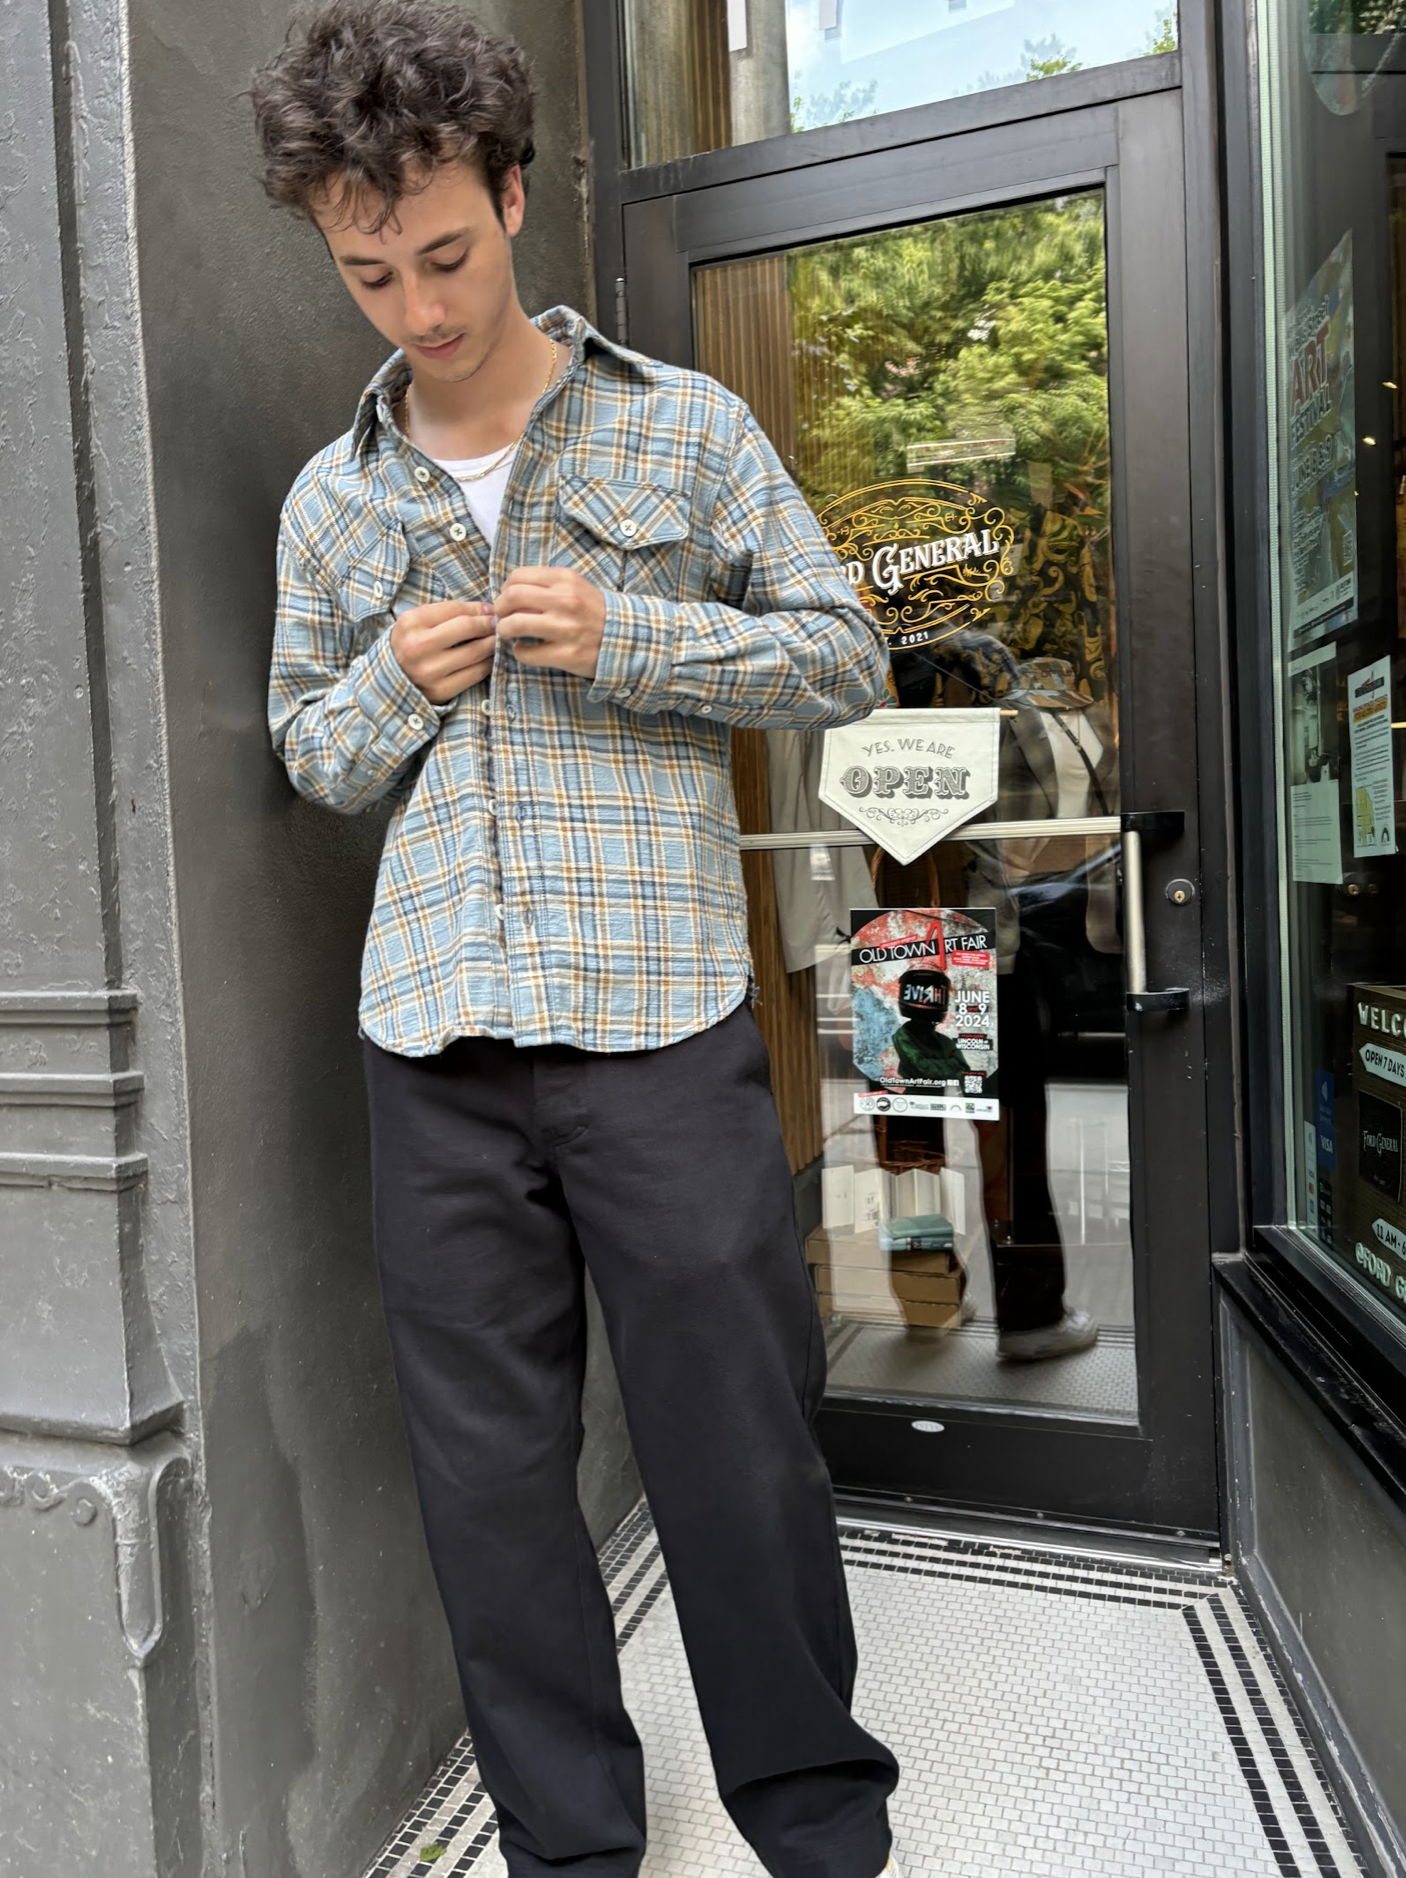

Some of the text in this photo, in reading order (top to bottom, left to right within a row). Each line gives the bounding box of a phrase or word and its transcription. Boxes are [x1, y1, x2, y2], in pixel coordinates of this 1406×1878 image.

[1291, 319, 1330, 412] ART
[872, 529, 1000, 596] GENERAL
[901, 631, 929, 646] 2021
[897, 738, 925, 752] WE
[926, 741, 956, 759] ARE
[840, 765, 971, 800] OPEN
[859, 947, 888, 964] OLD
[888, 941, 936, 960] TOWN
[961, 934, 988, 951] FAIR
[954, 990, 990, 1004] JUNE
[958, 1003, 967, 1015] 8
[978, 1003, 987, 1015] 9
[1357, 1002, 1406, 1039] WELC
[955, 1015, 990, 1028] 2024
[1365, 1049, 1405, 1078] OPEN 7 DAYS
[879, 1076, 947, 1087] OldTownArtFair.org
[1320, 1134, 1334, 1154] VISA
[1376, 1223, 1384, 1240] 11
[1385, 1230, 1397, 1249] AM
